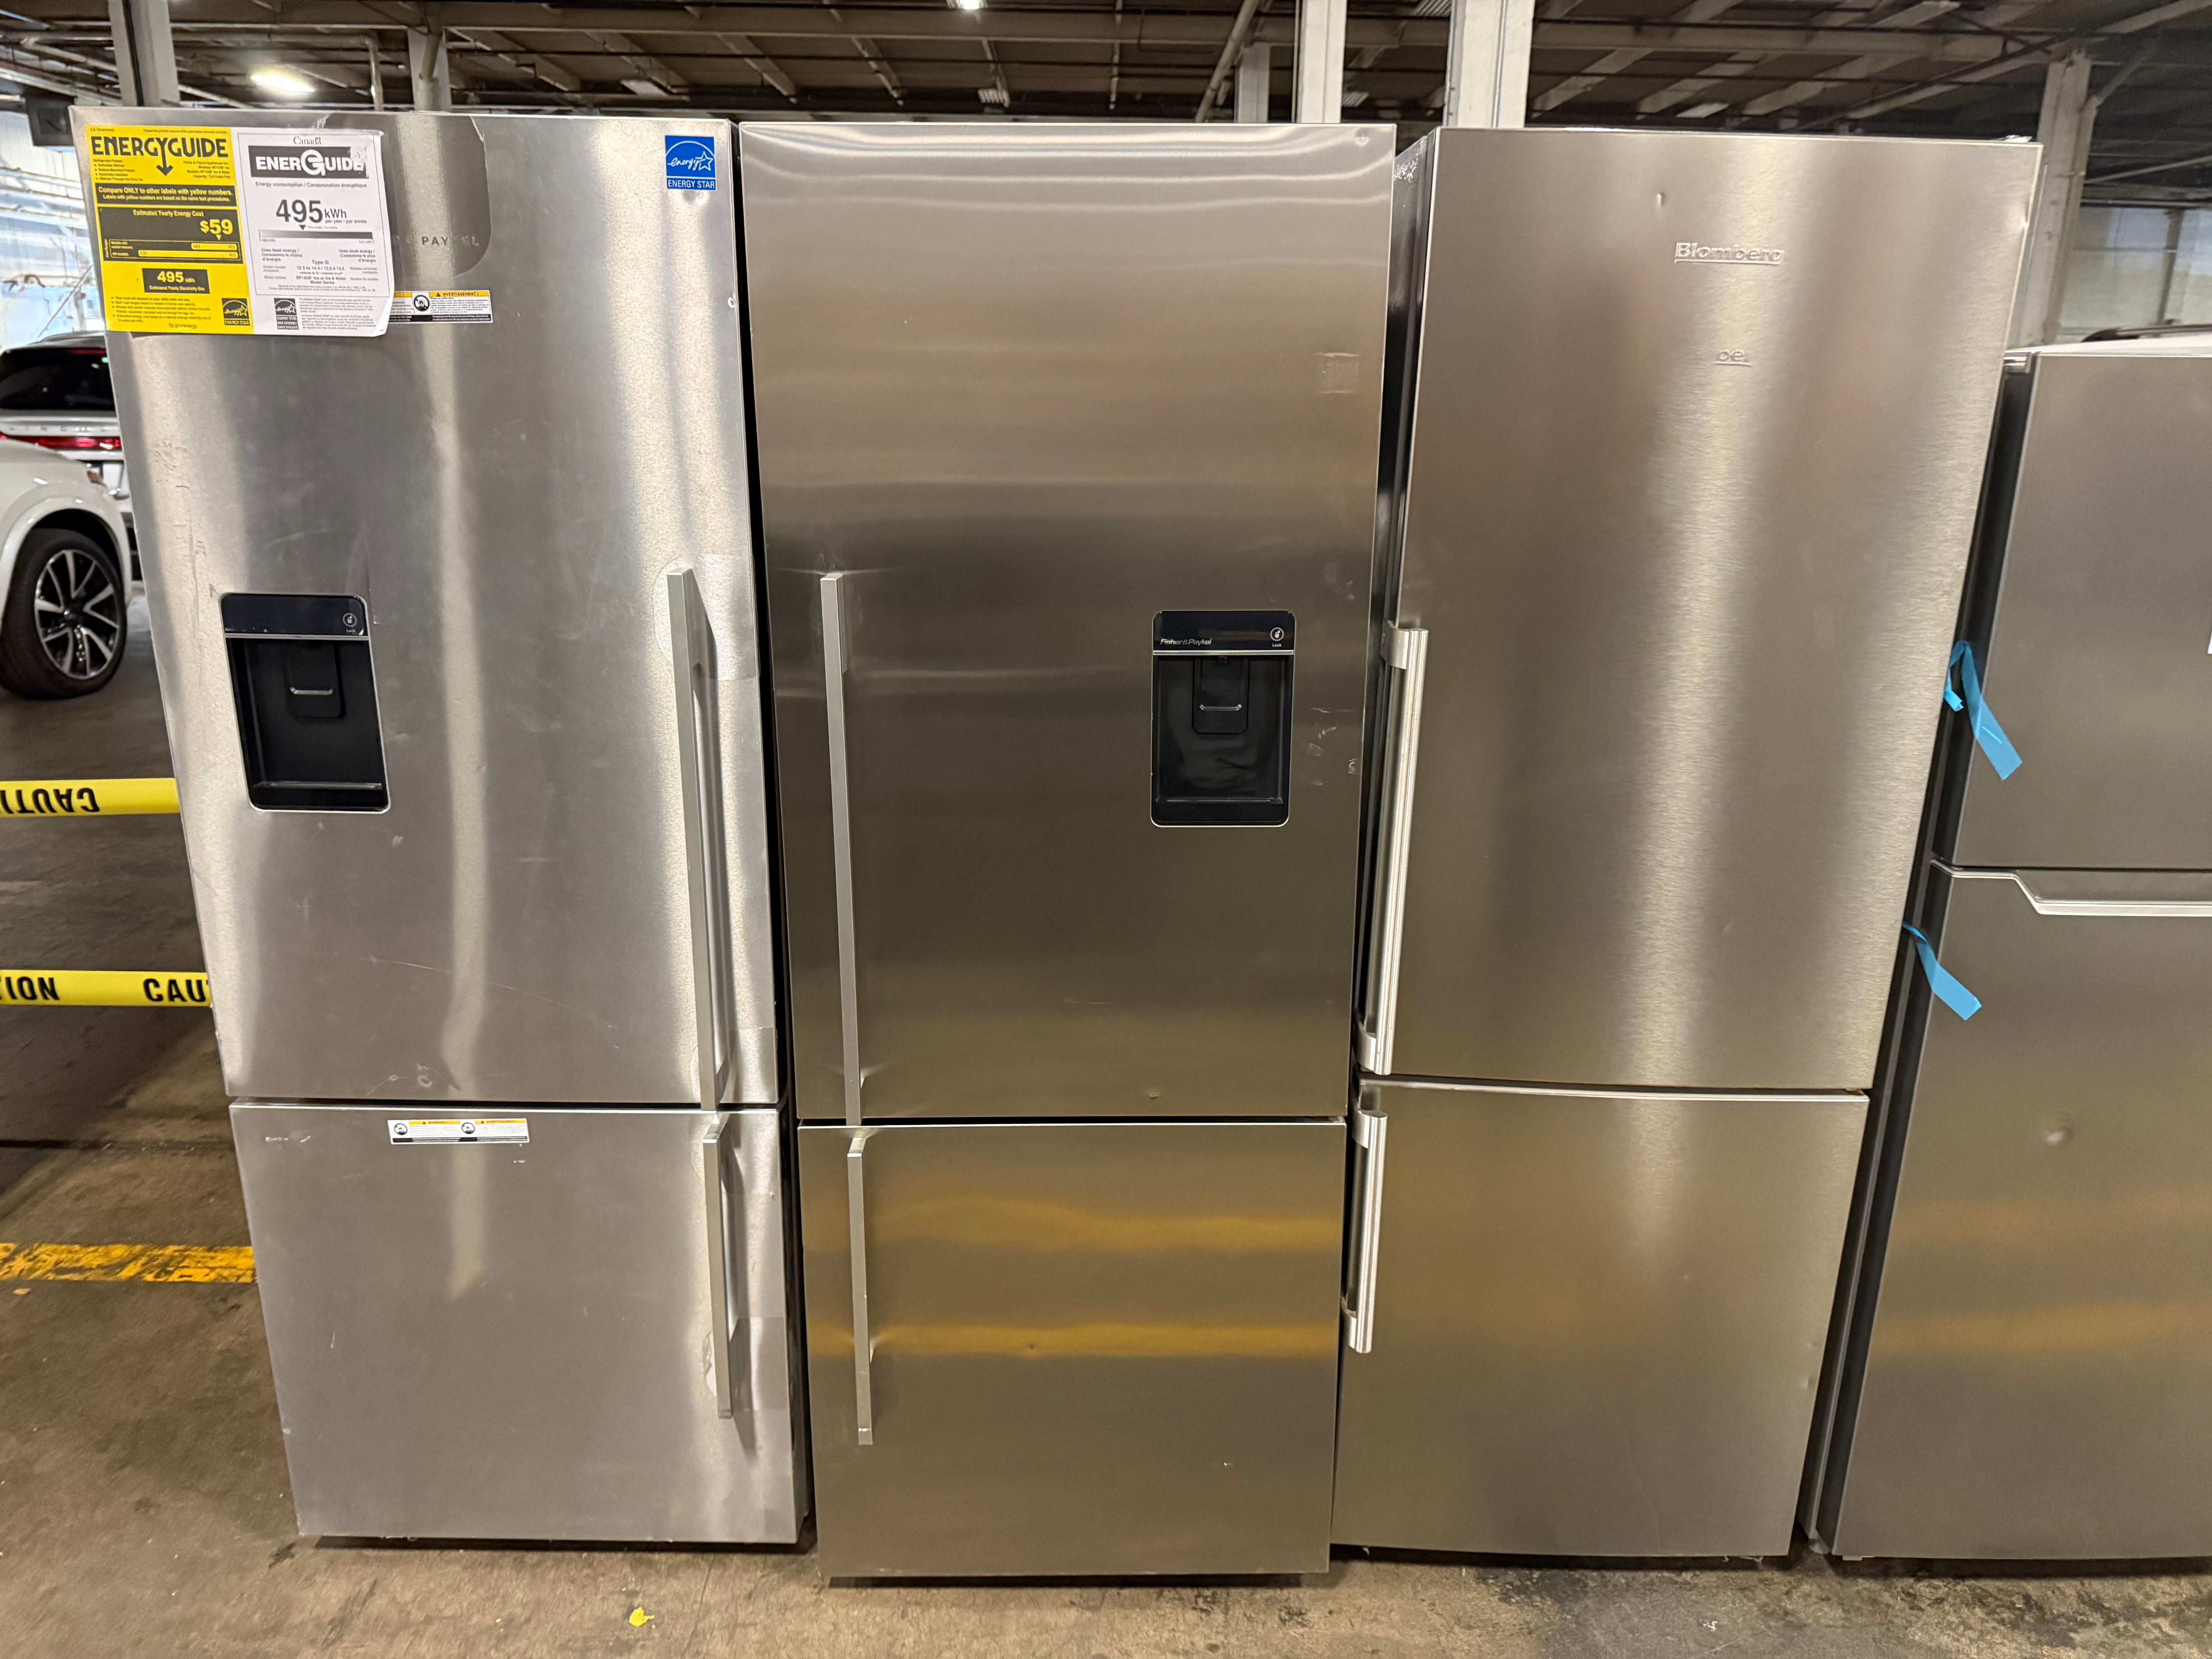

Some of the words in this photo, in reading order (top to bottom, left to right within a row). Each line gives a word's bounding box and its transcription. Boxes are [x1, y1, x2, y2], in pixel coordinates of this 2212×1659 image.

[91, 136, 228, 158] ENERGYGUIDE
[256, 149, 364, 176] ENERGUIDE
[667, 157, 703, 171] energy
[668, 179, 695, 188] ENERGY
[697, 180, 715, 189] STAR
[276, 199, 323, 223] 495
[324, 208, 347, 218] kWh
[200, 219, 233, 235] $59
[1674, 242, 1785, 264] Blomberg
[157, 271, 184, 283] 495
[0, 976, 60, 1000] ION
[143, 978, 209, 1002] CAU
